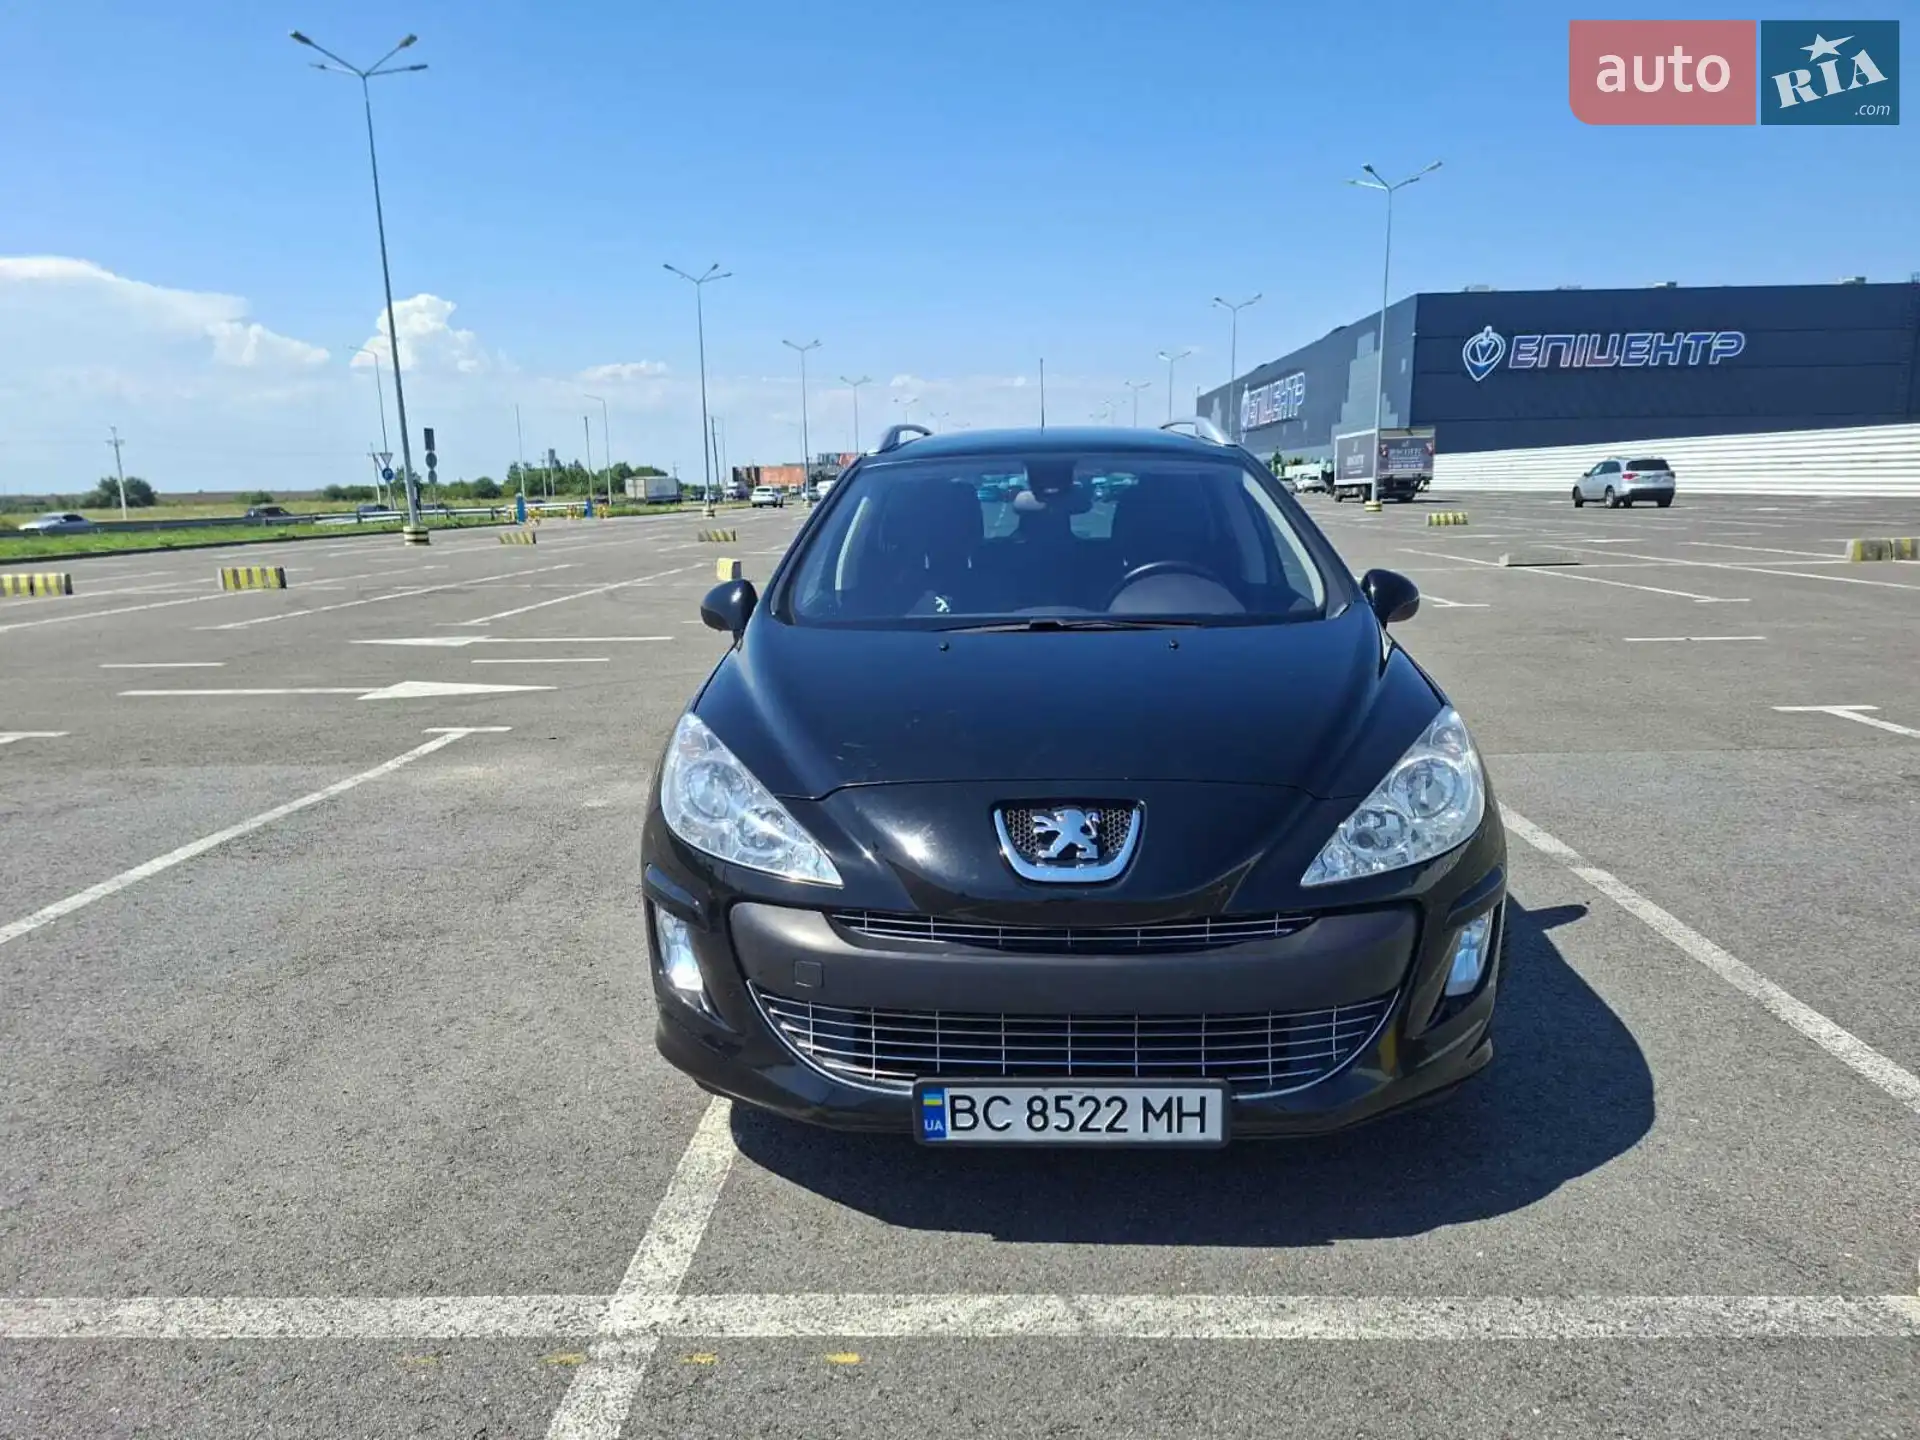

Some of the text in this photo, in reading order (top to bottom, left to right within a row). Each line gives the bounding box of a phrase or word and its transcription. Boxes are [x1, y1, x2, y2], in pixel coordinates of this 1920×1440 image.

[1508, 331, 1746, 369] ЕПІЦЕНТР
[924, 1119, 944, 1131] UA
[949, 1094, 1207, 1133] BC 8522 MH
